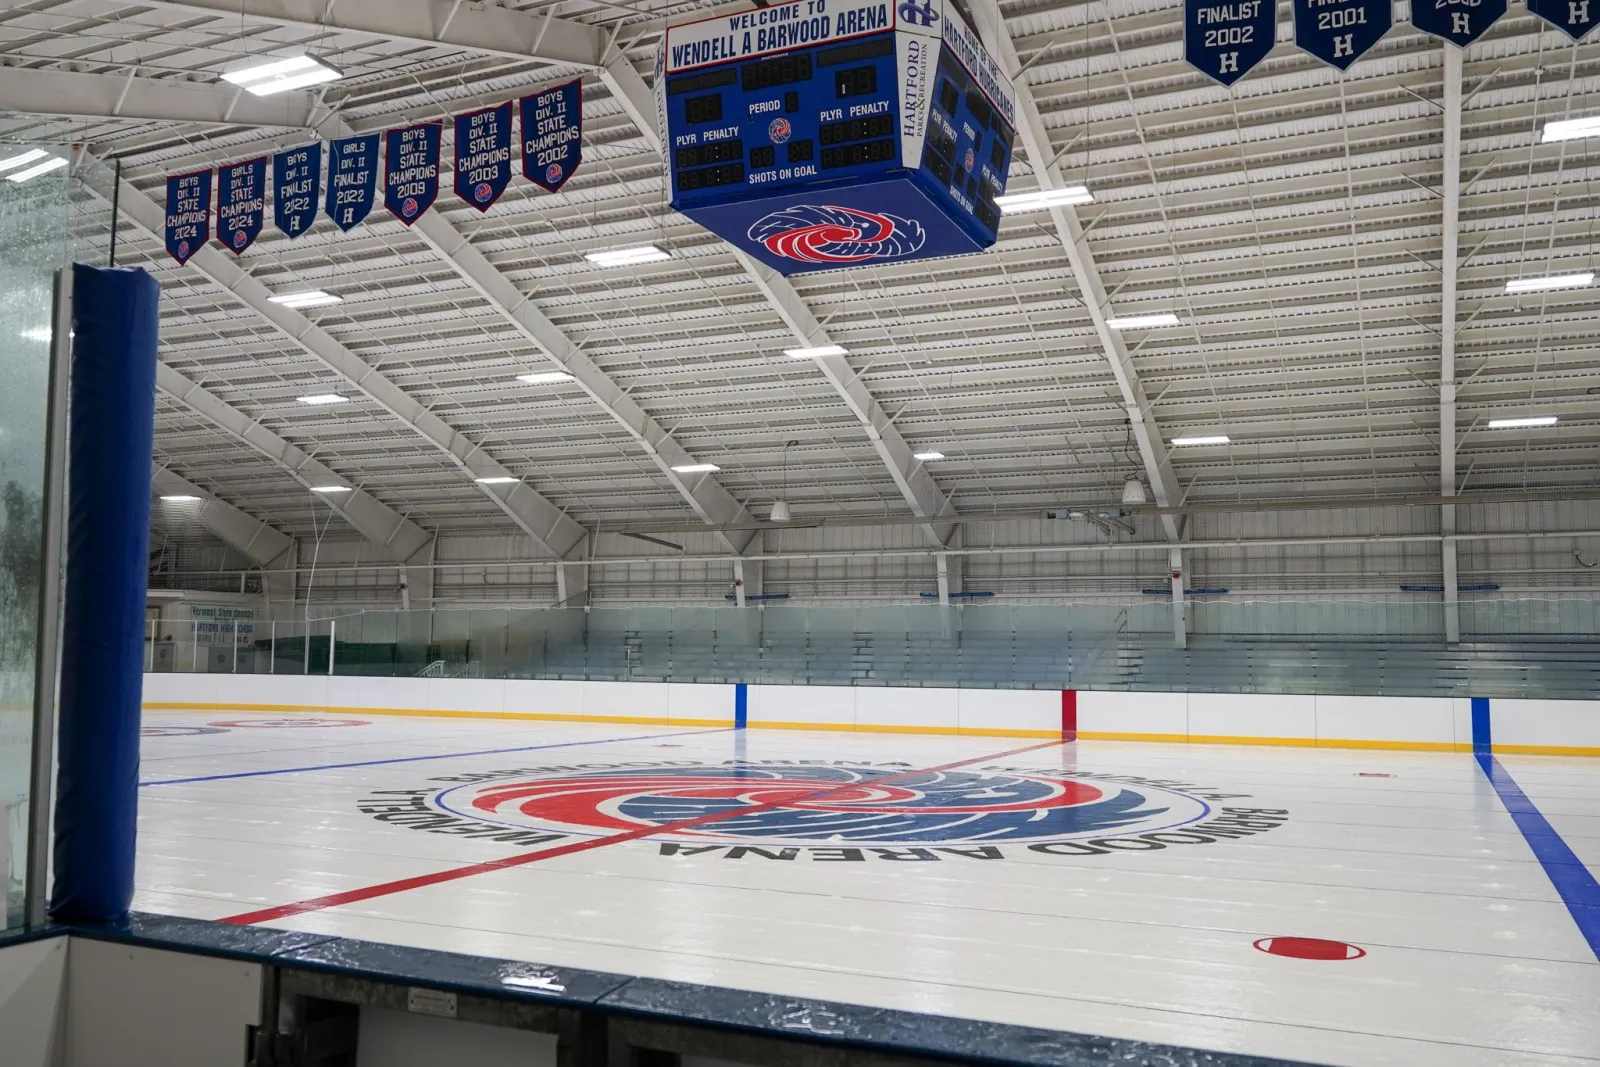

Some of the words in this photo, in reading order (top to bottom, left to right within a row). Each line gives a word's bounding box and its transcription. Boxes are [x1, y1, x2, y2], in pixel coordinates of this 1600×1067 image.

[730, 4, 800, 31] WELCOME
[808, 0, 826, 15] TO
[1197, 1, 1262, 24] FINALIST
[1318, 7, 1367, 30] 2001
[1568, 0, 1590, 24] H
[1452, 12, 1470, 34] H
[672, 35, 736, 68] WENDELL
[742, 32, 752, 54] A
[758, 16, 830, 52] BARWOOD
[836, 4, 888, 36] ARENA
[1205, 26, 1254, 47] 2002
[1333, 33, 1354, 58] H
[944, 15, 978, 78] HARTFORD
[1220, 52, 1238, 74] H
[538, 90, 563, 106] BOYS
[904, 40, 920, 137] HARTFORD
[536, 106, 553, 120] DIV.
[557, 102, 566, 113] II
[749, 100, 780, 114] PERIOD
[820, 109, 842, 122] PLYR
[850, 101, 889, 117] PENALTY
[472, 112, 495, 126] BOYS
[538, 115, 566, 135] STATE
[402, 129, 425, 141] BOYS
[469, 126, 485, 139] DIV.
[489, 122, 497, 133] II
[526, 126, 579, 154] CHAMPIONS
[676, 134, 696, 146] PLYR
[703, 126, 739, 141] PENALTY
[943, 120, 958, 142] PENALTY
[963, 122, 975, 140] PERIOD
[343, 142, 365, 154] GIRLS
[400, 142, 415, 154] DIV.
[419, 140, 427, 150] II
[469, 136, 497, 153] STATE
[287, 152, 307, 165] BOYS
[400, 153, 425, 169] STATE
[459, 147, 509, 172] CHAMPIONS
[538, 145, 568, 166] 2002
[231, 165, 253, 177] GIRLS
[334, 171, 369, 187] FINALIST
[389, 165, 436, 185] CHAMPIONS
[469, 166, 498, 185] 2003
[749, 170, 776, 184] SHOTS
[780, 169, 791, 179] ON
[794, 165, 817, 178] GOAL
[179, 176, 198, 188] BOYS
[281, 178, 313, 199] FINALIST
[397, 182, 425, 198] 2009
[231, 186, 253, 202] STATE
[337, 190, 365, 204] 2022
[178, 198, 199, 213] STATE
[221, 197, 263, 218] CHAMPIONS
[284, 197, 310, 213] 2022
[167, 209, 206, 227] CHAMPIONS
[228, 215, 253, 230] 2024
[174, 225, 197, 240] 2024
[192, 623, 218, 632] HRTFORD
[426, 760, 704, 782] BARWOOD
[356, 796, 570, 846] WENDELL
[1027, 806, 1288, 856] BARWOOD
[659, 843, 1006, 862] ARENA
